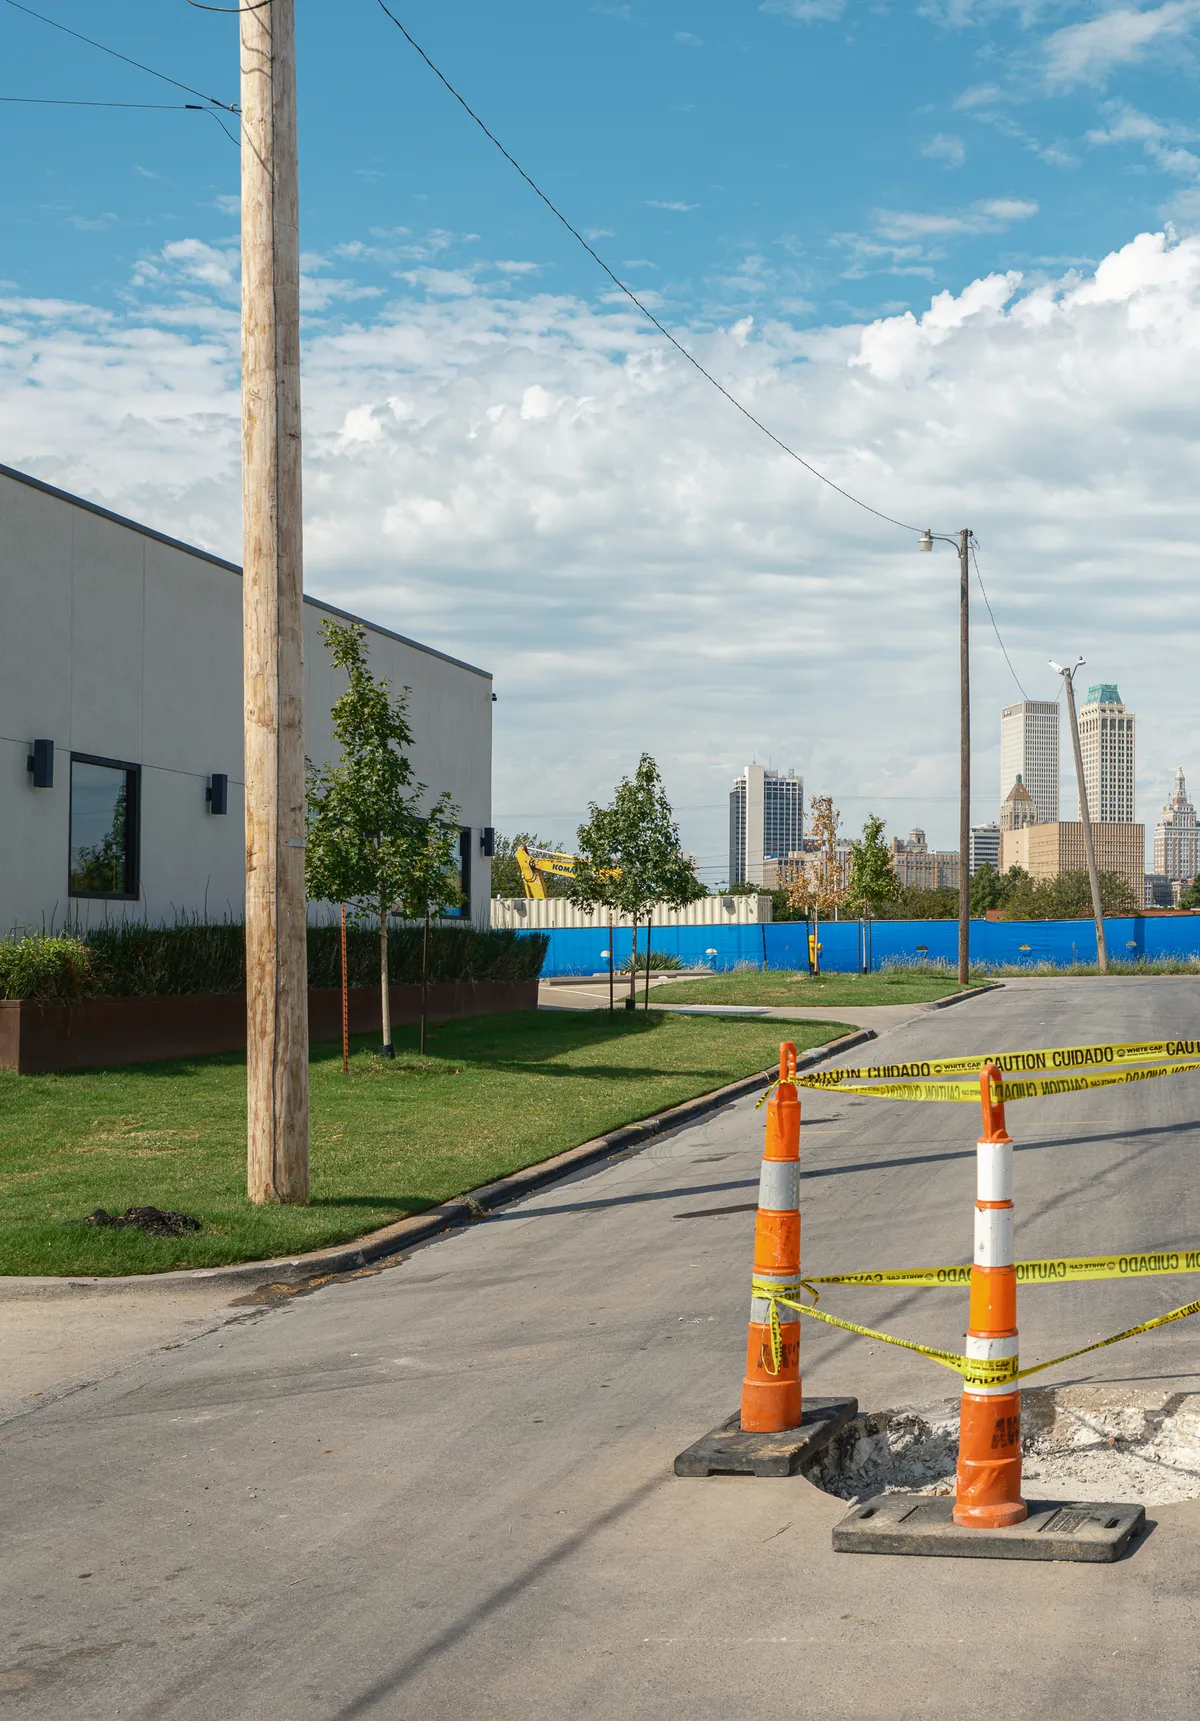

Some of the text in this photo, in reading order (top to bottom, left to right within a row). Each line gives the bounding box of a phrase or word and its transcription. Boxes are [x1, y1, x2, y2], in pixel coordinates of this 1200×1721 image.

[552, 863, 576, 873] KOMA
[868, 1062, 930, 1079] CUIDADO
[1052, 1047, 1113, 1067] CUIDADO
